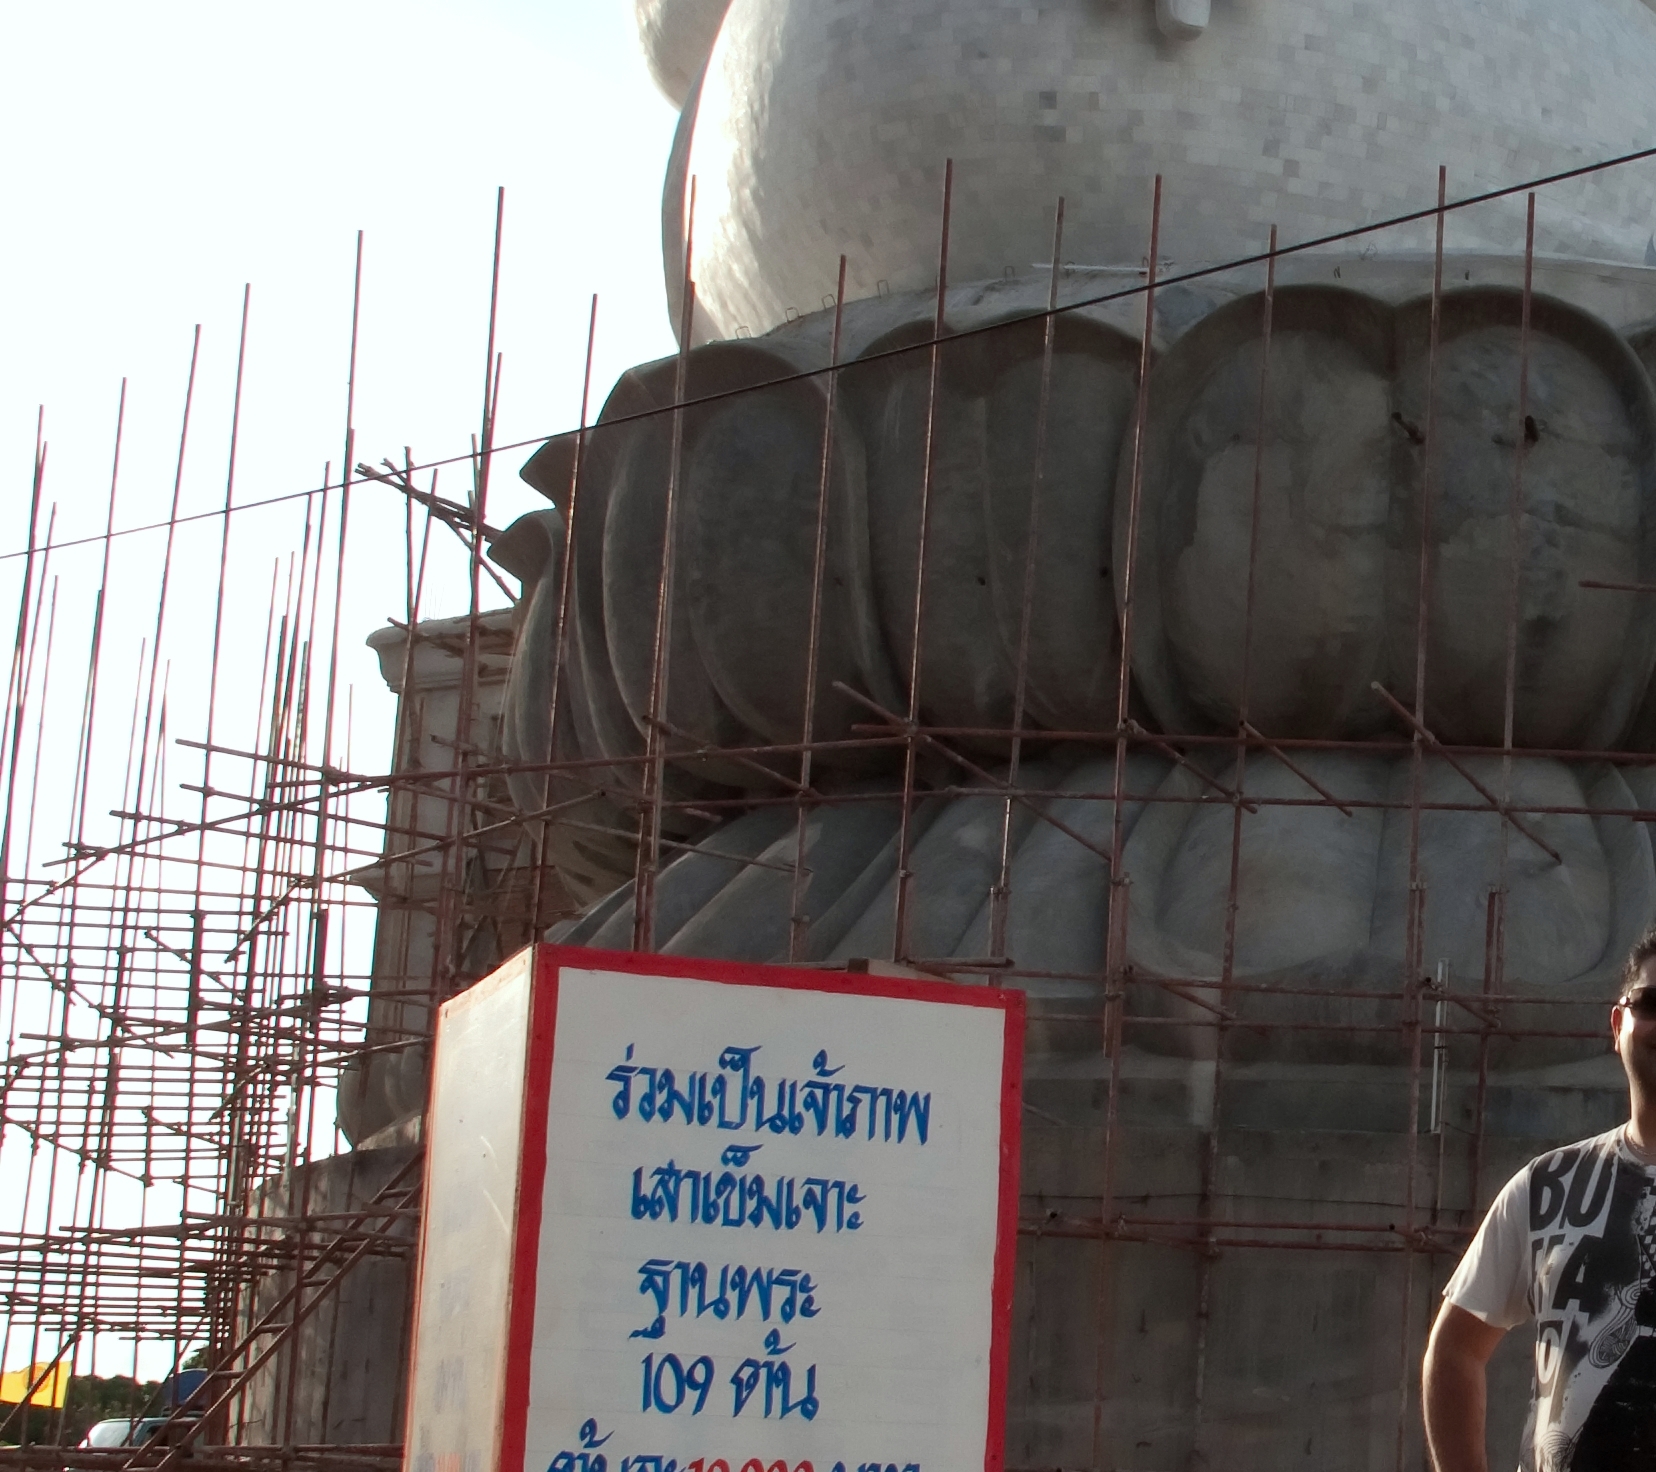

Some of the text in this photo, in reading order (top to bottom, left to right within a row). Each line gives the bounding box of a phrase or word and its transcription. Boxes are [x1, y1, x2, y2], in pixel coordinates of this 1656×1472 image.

[605, 1042, 932, 1145] ร่วมเป็นเจ้าภาพ
[629, 1144, 867, 1233] เสาเข็มเจาะ
[628, 1258, 822, 1341] ฐานพระ
[640, 1328, 820, 1422] 109 ต้น
